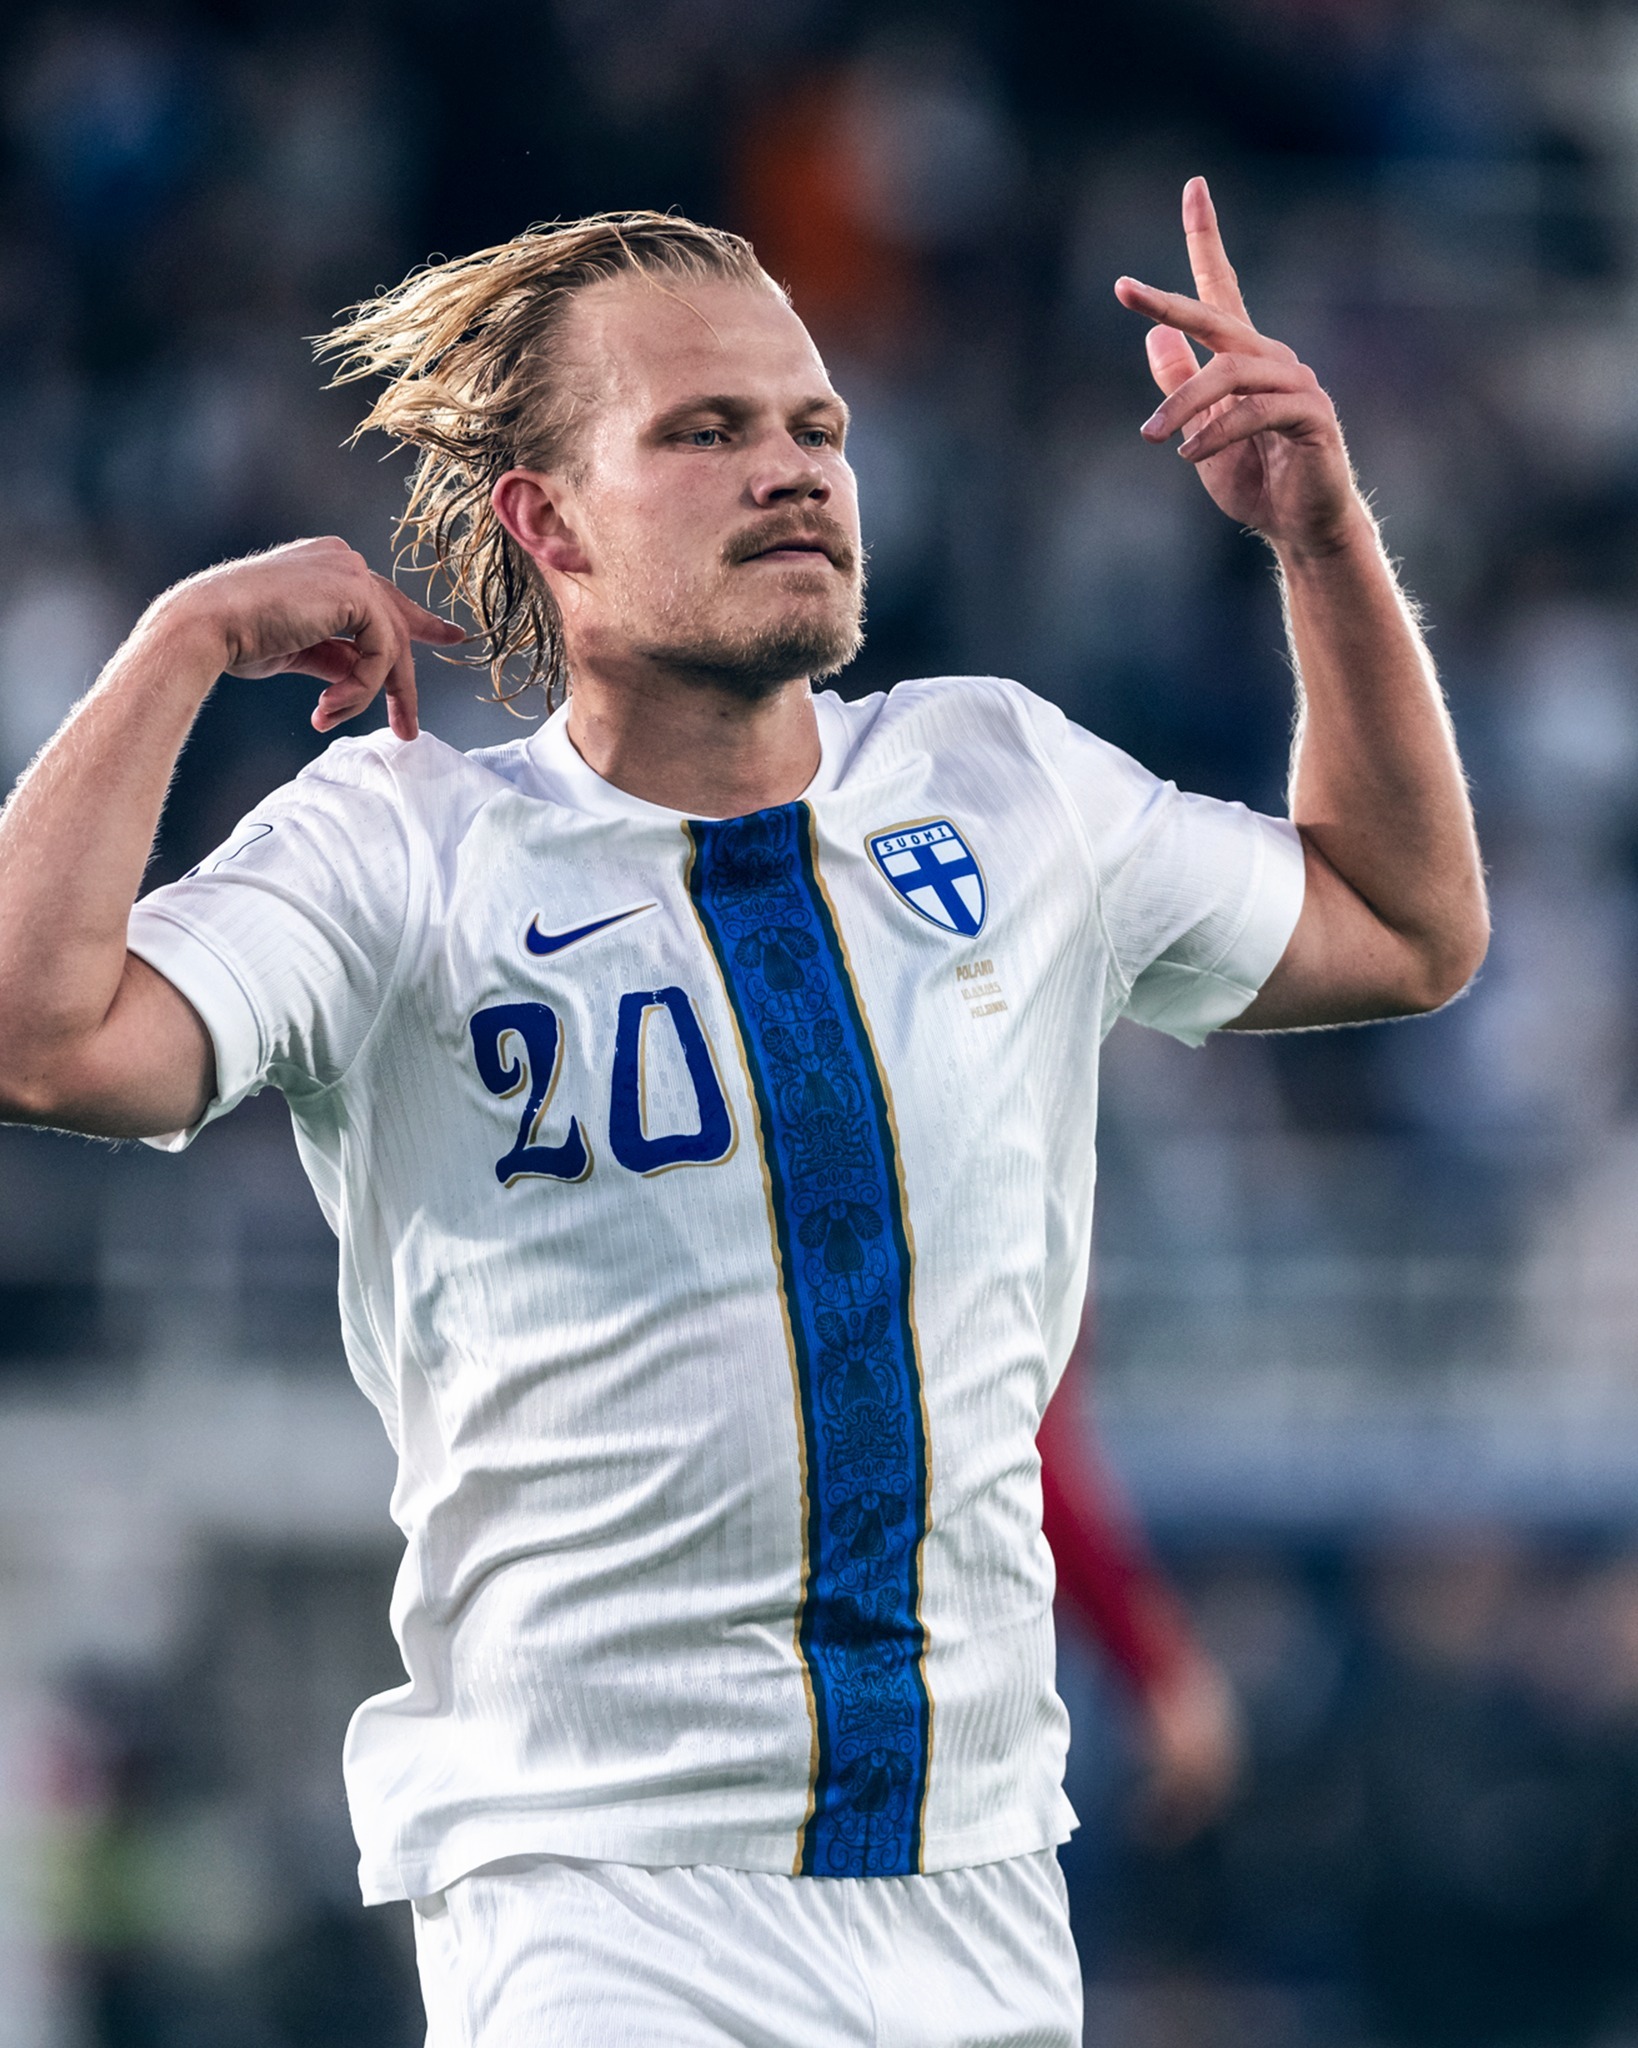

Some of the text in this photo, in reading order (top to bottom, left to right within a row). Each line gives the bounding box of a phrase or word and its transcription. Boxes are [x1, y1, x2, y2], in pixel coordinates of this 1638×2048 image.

[883, 827, 947, 852] SUOMI
[956, 959, 994, 982] POLAND
[469, 985, 740, 1189] 20
